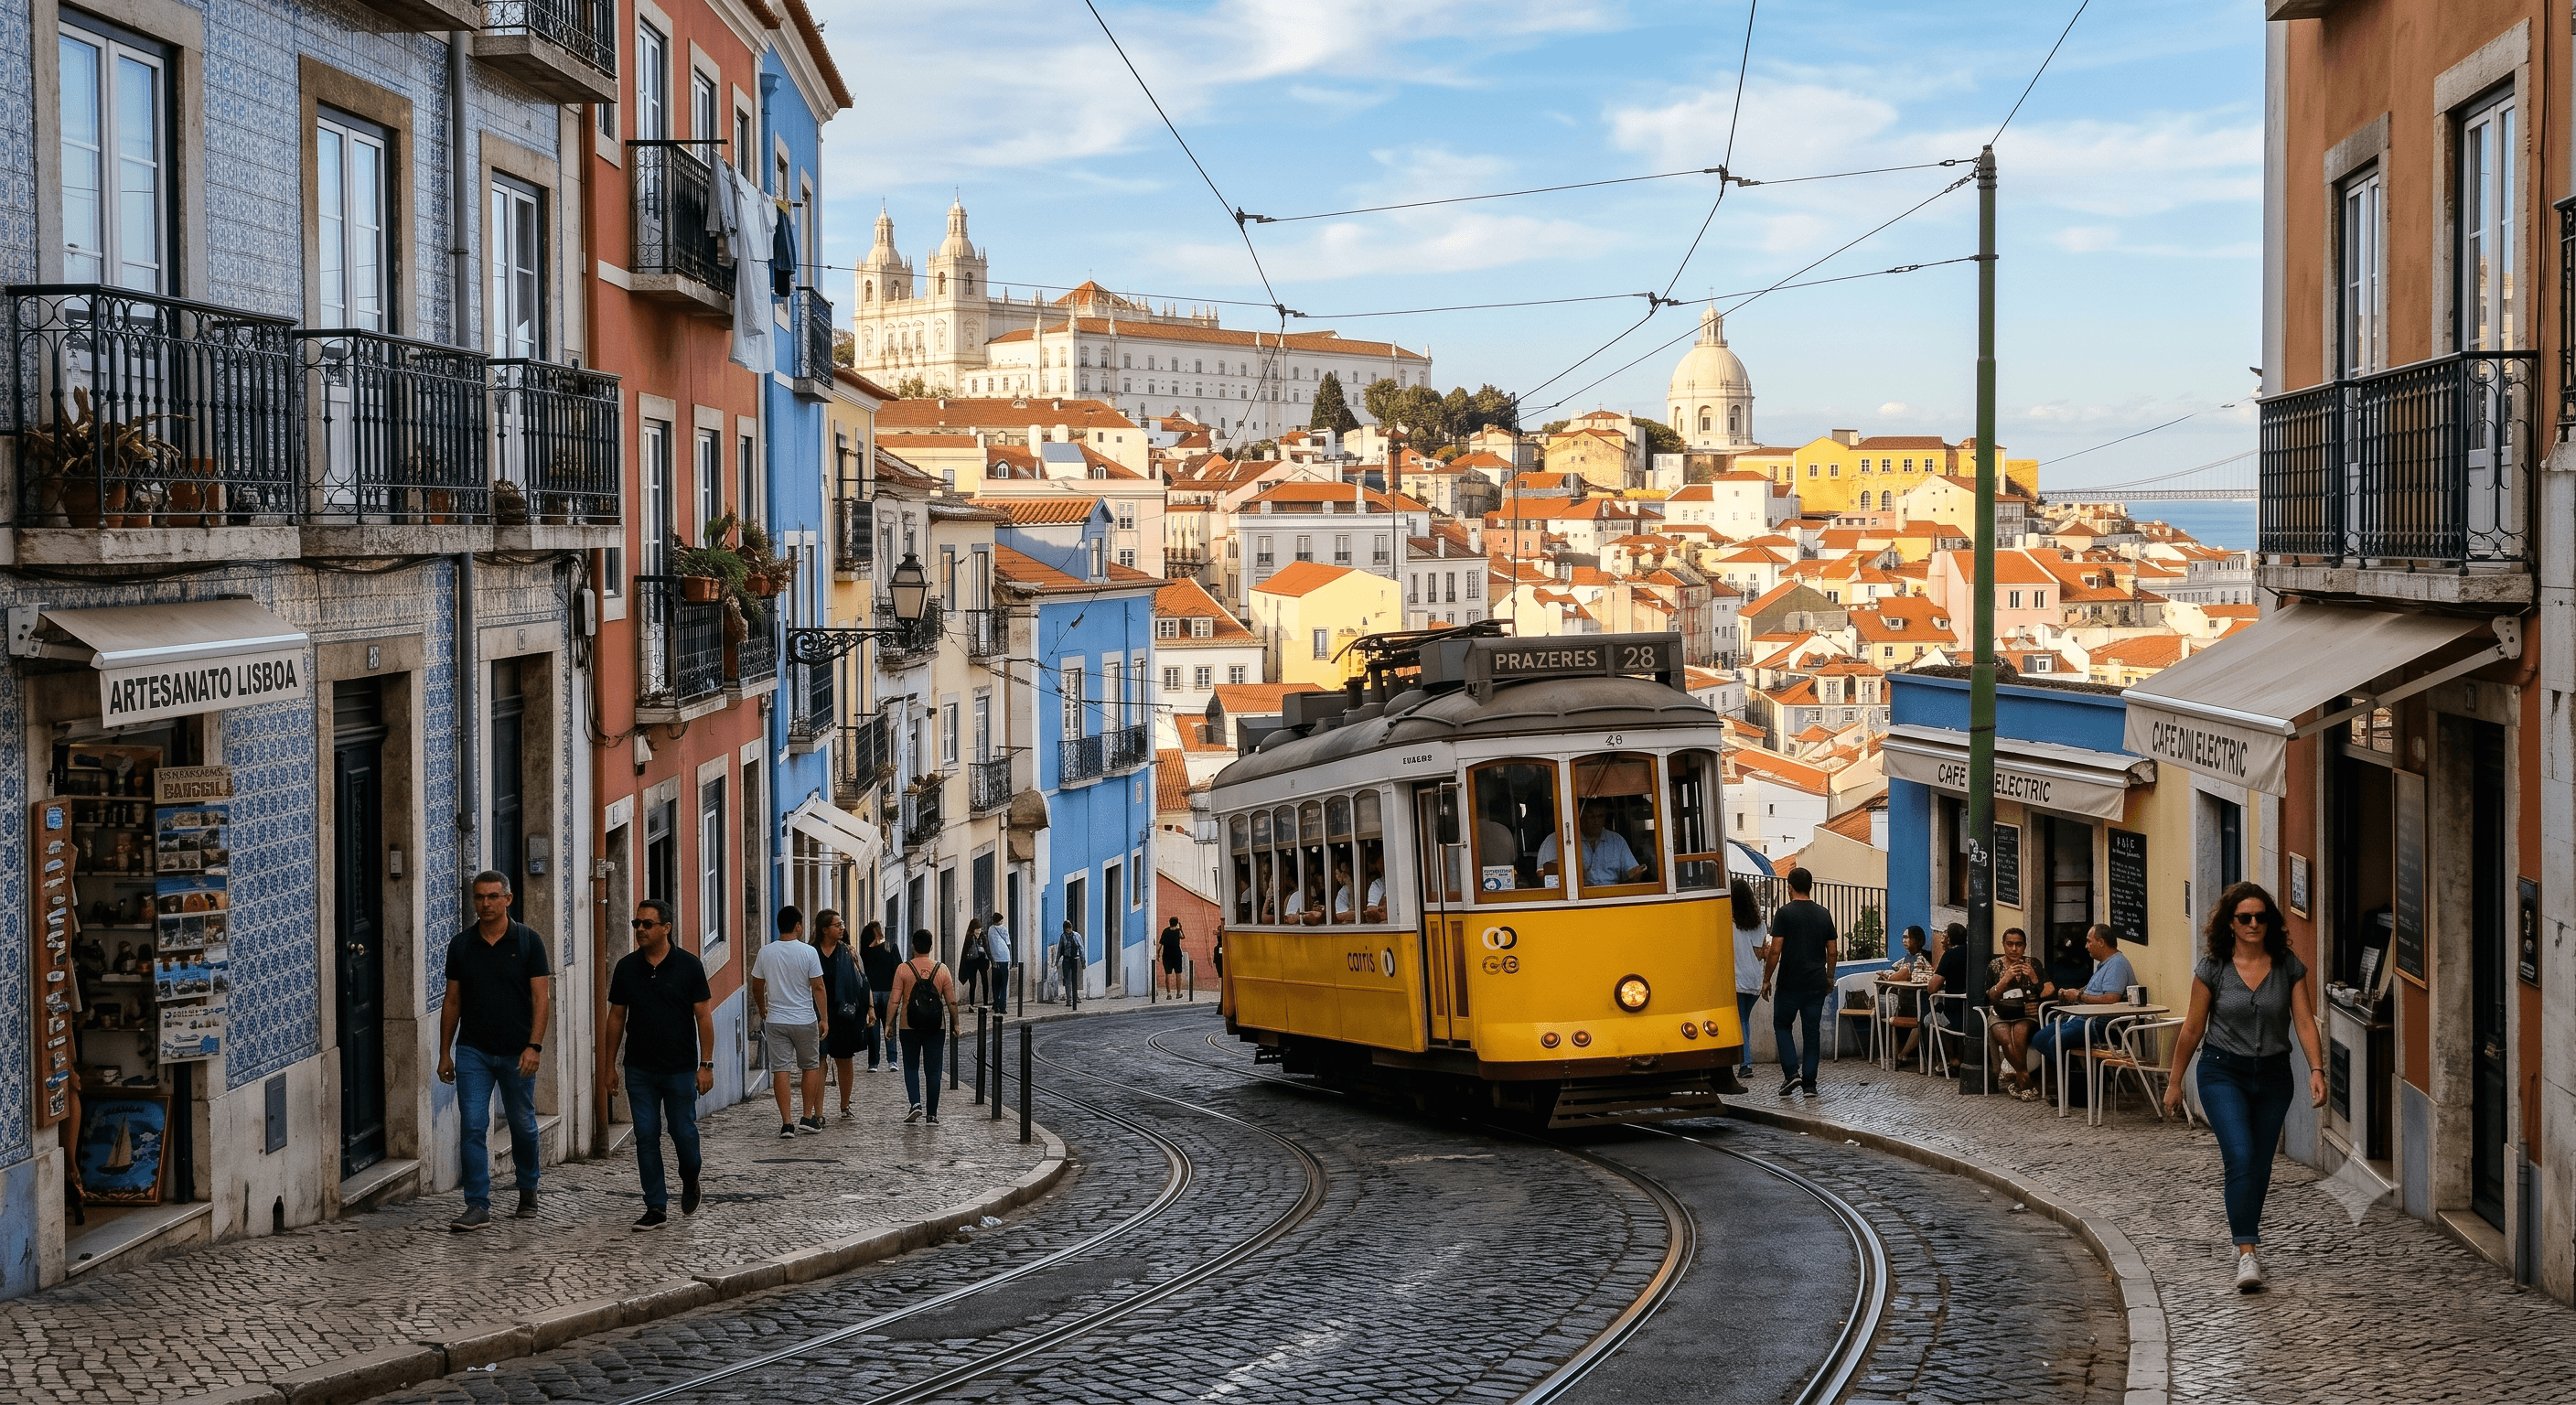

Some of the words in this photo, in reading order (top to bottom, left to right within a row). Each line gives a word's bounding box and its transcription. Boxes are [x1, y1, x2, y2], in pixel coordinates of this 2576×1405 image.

[1495, 649, 1597, 670] PRAZERES
[1623, 646, 1656, 669] 28
[109, 666, 231, 715] ARTESANATO
[237, 659, 298, 696] LISBOA
[2152, 715, 2177, 757] CAFÉ
[2195, 731, 2248, 778] ELECTRIC
[1994, 772, 2051, 803] ELECTRIC
